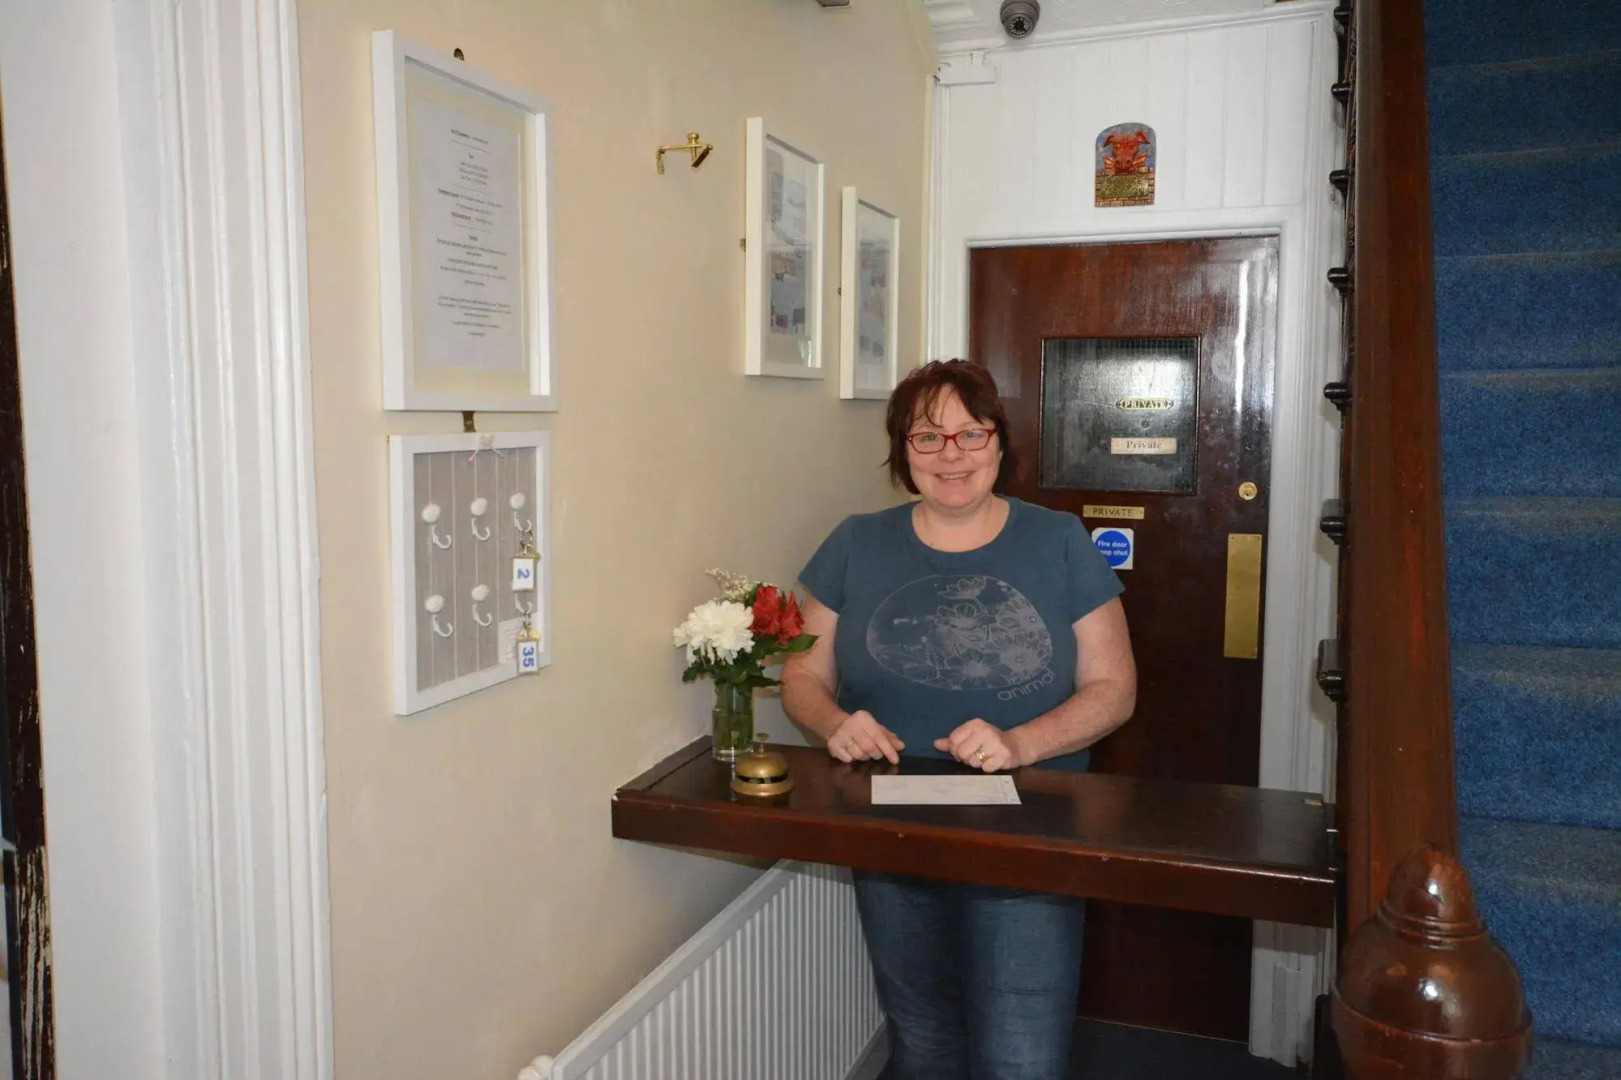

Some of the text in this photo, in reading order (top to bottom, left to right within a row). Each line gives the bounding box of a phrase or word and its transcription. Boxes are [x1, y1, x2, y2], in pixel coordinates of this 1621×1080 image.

[1124, 400, 1167, 409] PRIVATE
[1126, 440, 1163, 449] Private
[1092, 507, 1133, 517] PRIVATE
[517, 568, 530, 579] 2
[522, 646, 535, 667] 35
[997, 667, 1056, 700] animal
